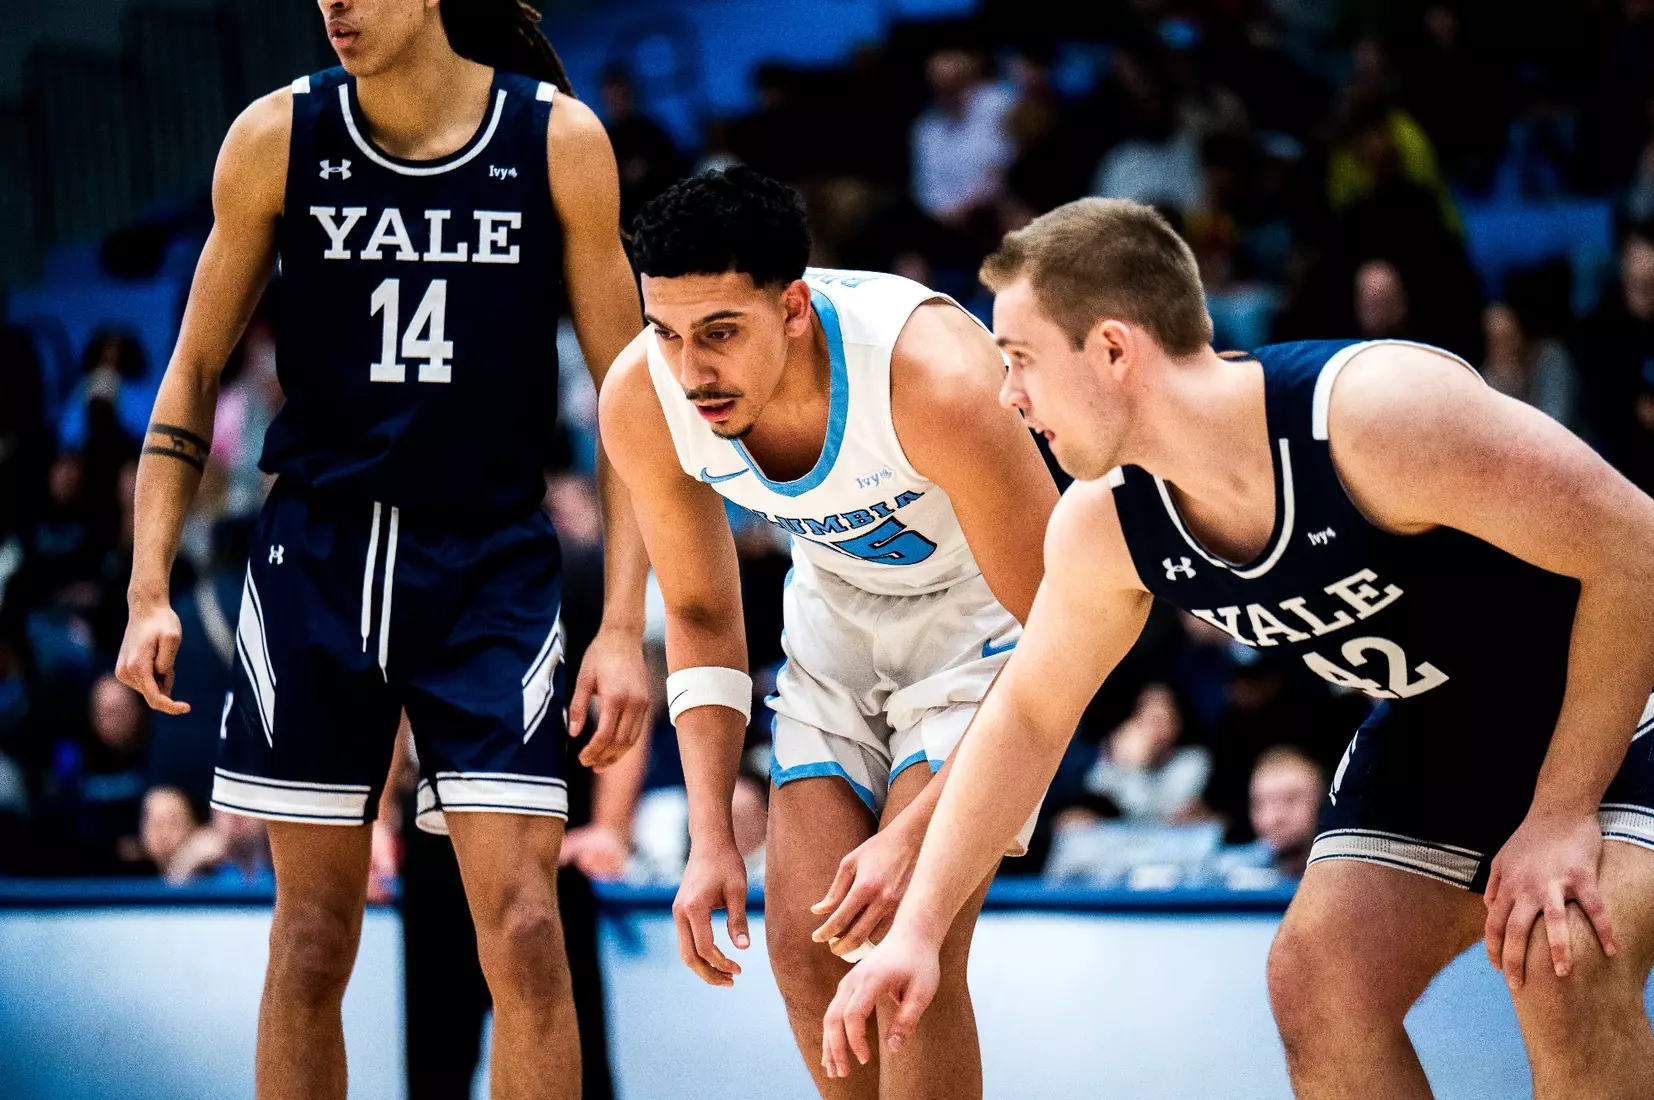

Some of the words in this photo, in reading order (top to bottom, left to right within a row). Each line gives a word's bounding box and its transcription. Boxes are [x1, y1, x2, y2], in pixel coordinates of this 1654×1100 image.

[309, 205, 522, 264] YALE
[370, 277, 454, 383] 14
[1190, 567, 1404, 647] YALE
[1302, 636, 1450, 699] 42
